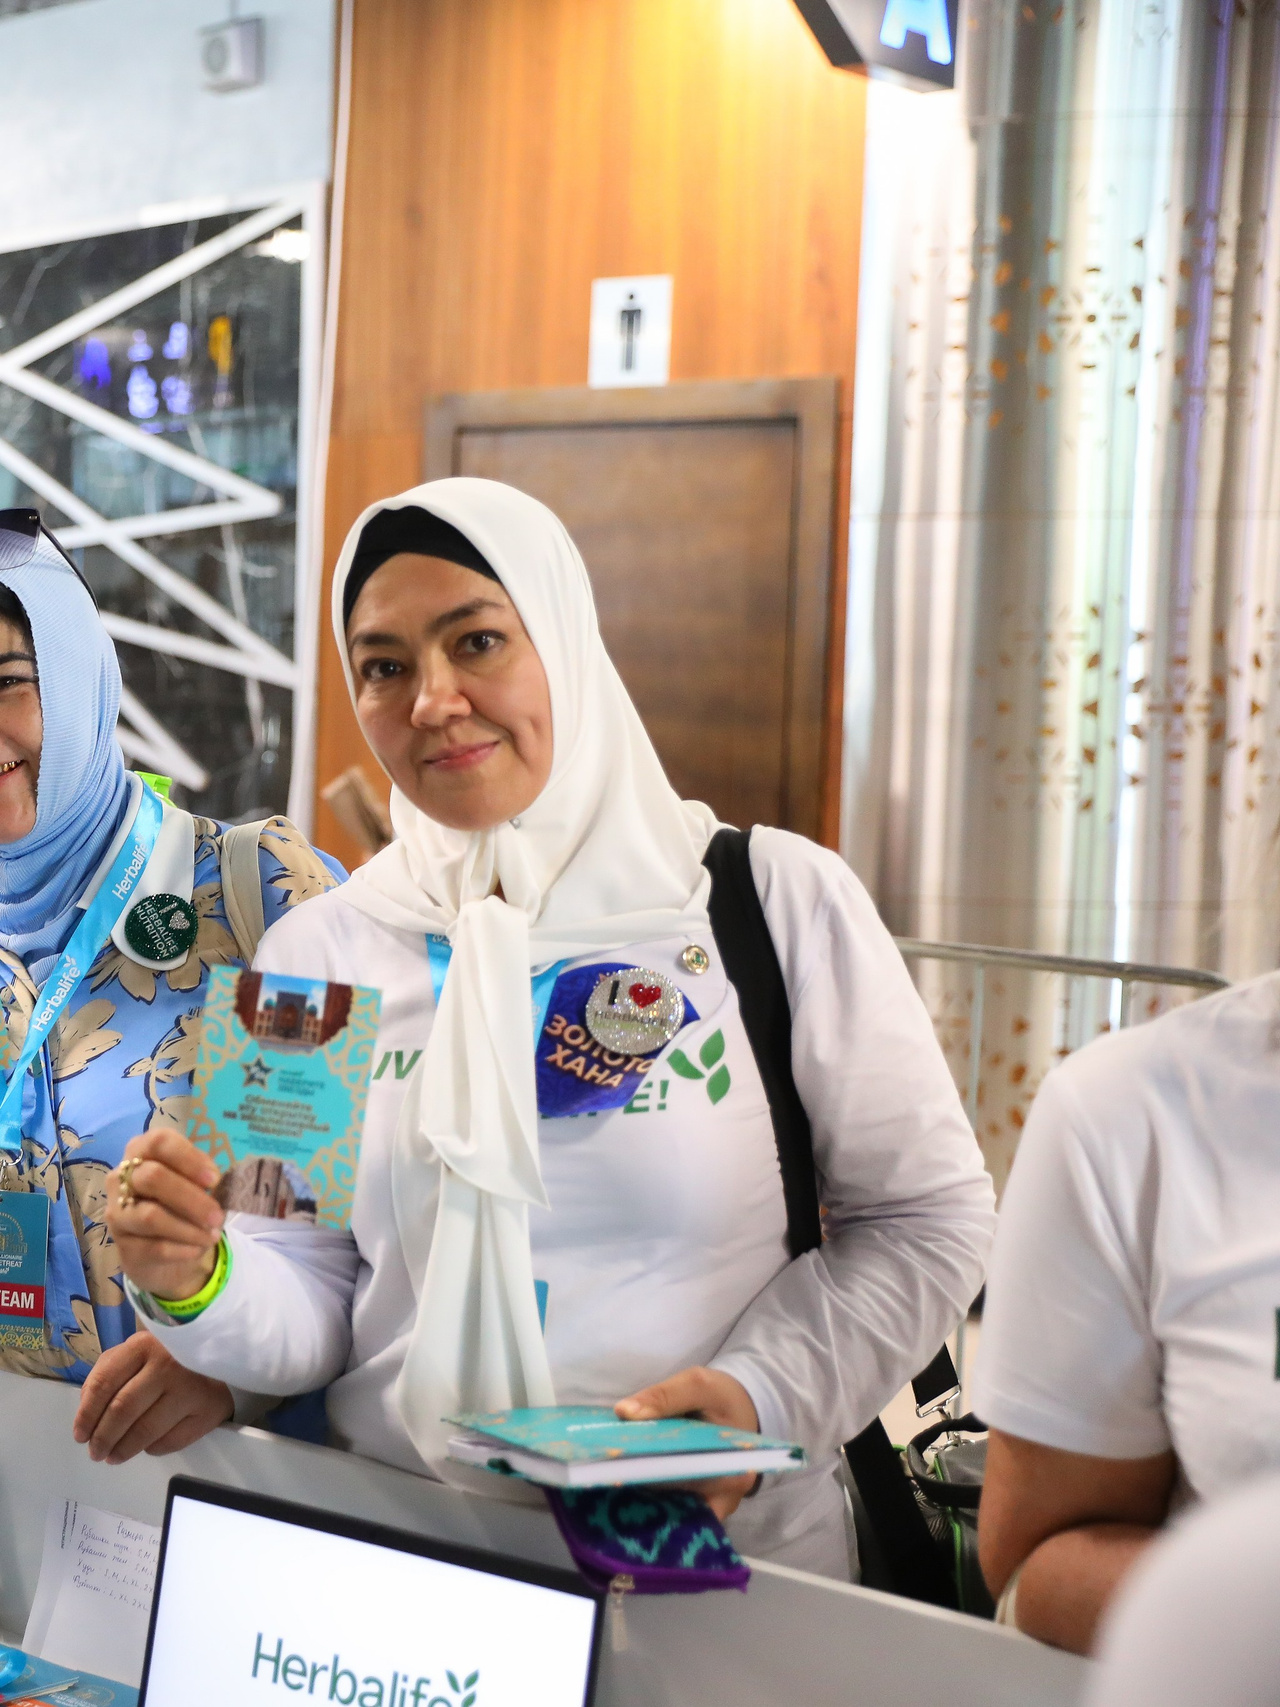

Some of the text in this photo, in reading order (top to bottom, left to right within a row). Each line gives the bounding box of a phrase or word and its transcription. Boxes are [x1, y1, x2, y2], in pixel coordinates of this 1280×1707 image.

[112, 843, 149, 900] Herbalife
[134, 905, 170, 957] NUTRITION
[32, 966, 80, 1032] Herbalife
[545, 1043, 624, 1088] ХАНА
